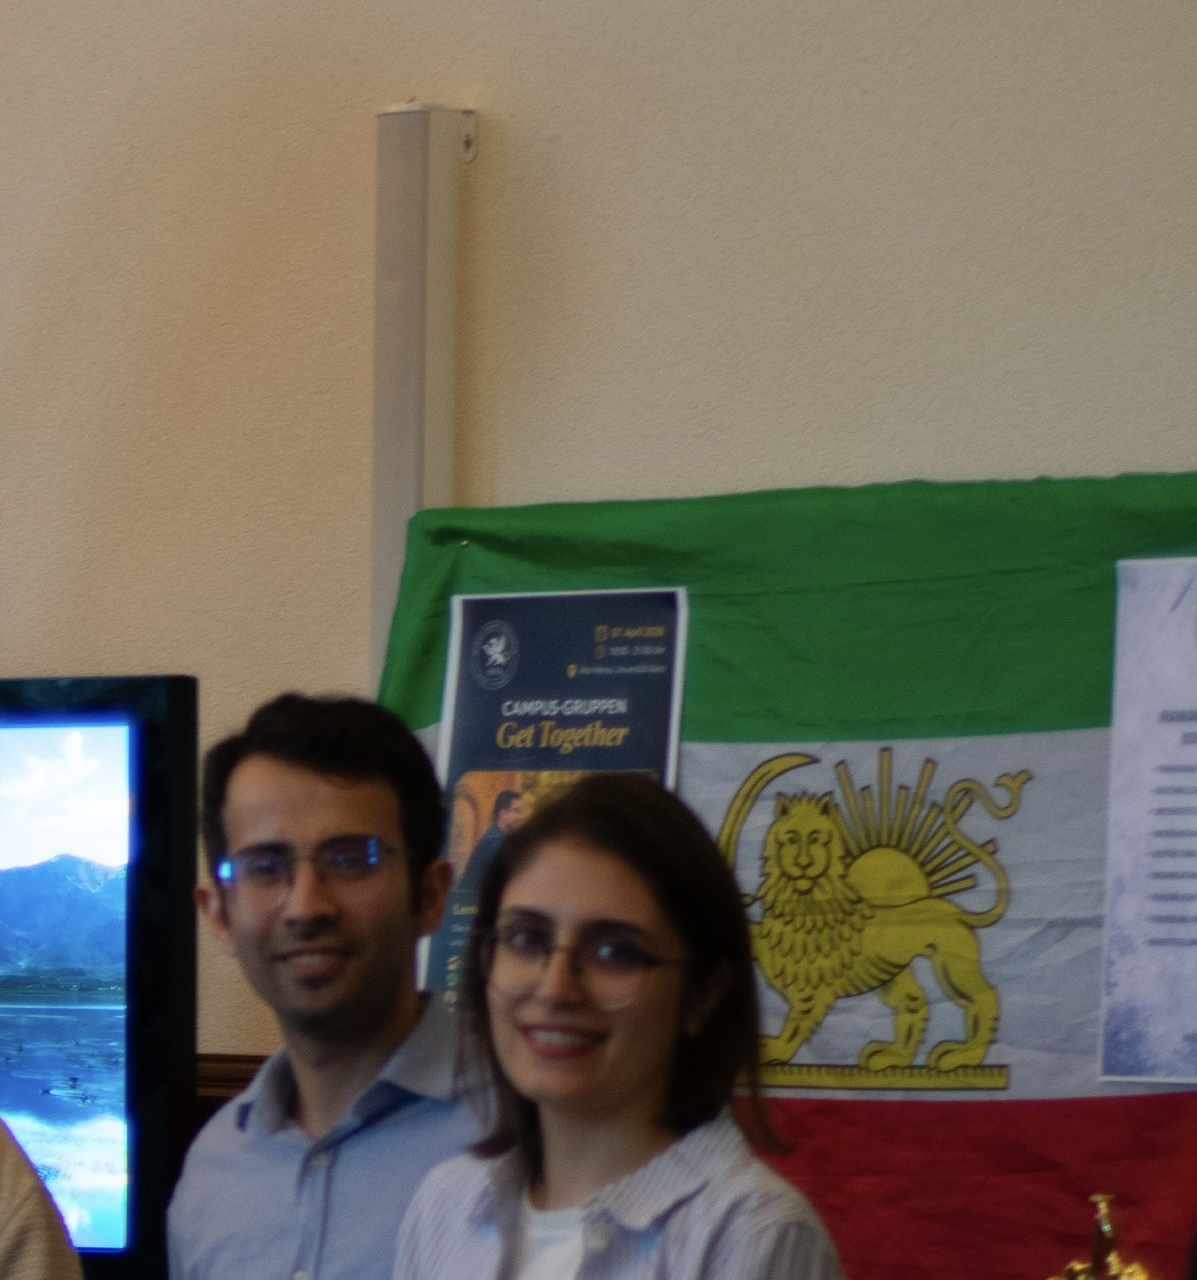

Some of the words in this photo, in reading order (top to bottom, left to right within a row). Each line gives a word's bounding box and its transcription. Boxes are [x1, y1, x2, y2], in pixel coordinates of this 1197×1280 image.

[501, 698, 629, 717] CAMPUS-GRUPPEN
[495, 721, 536, 749] Get
[539, 720, 629, 754] Together
